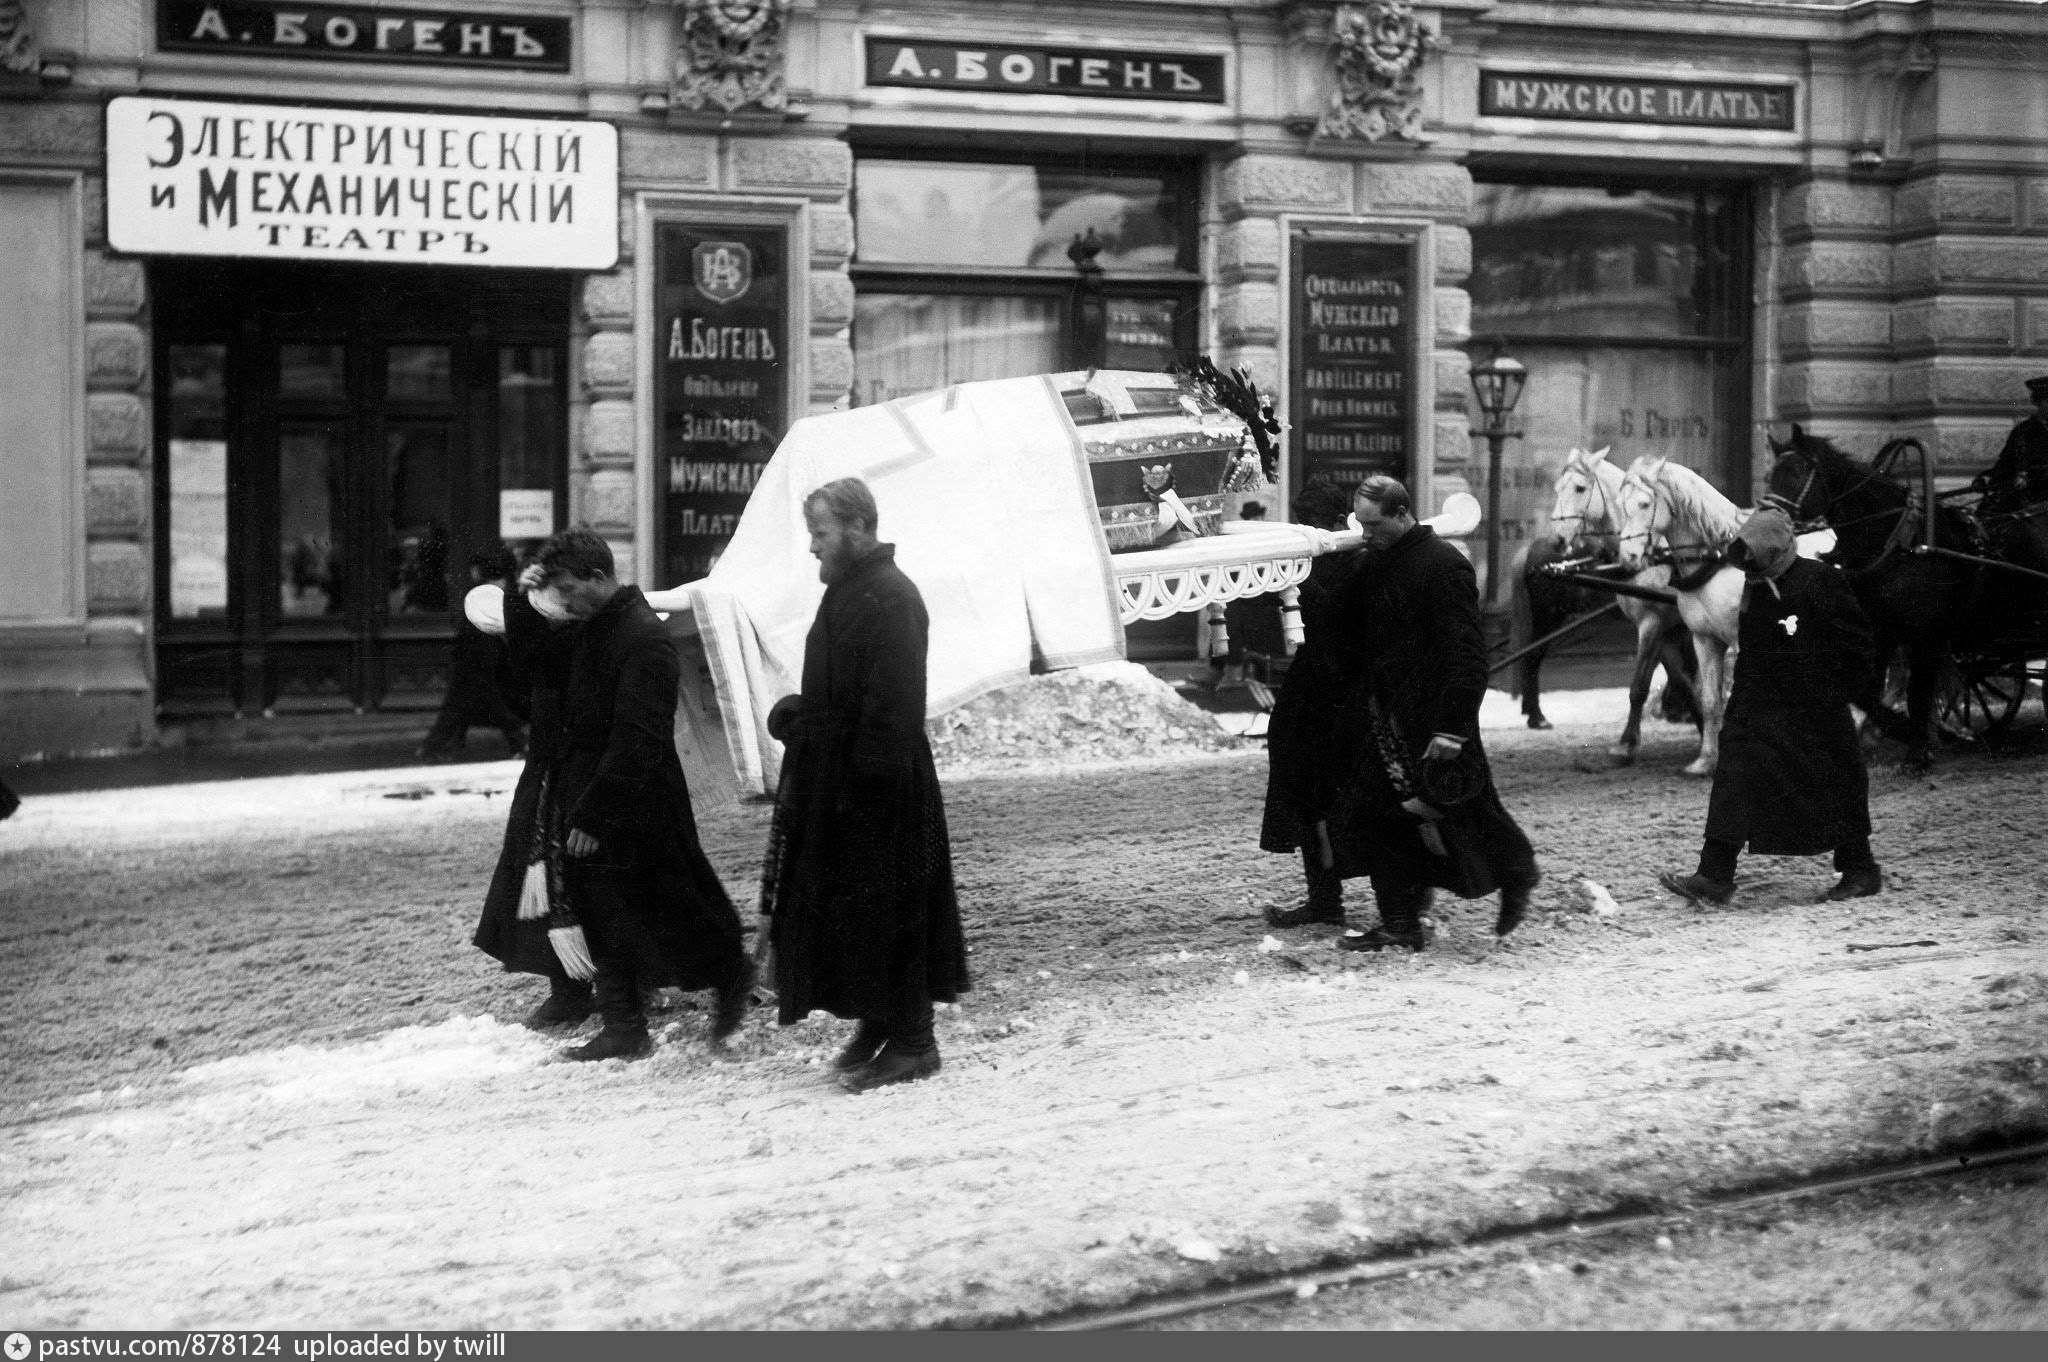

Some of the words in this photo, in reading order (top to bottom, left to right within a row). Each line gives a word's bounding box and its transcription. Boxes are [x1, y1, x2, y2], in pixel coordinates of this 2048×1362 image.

[193, 8, 252, 41] А.
[274, 12, 545, 57] БОГЕНЪ
[888, 47, 942, 78] А.
[955, 51, 1202, 91] БОГЕНЪ
[1496, 80, 1656, 115] МУЖСКОЕ
[1667, 88, 1782, 119] ПЛАТЬЕ
[147, 110, 581, 173] ЭЛЕКТРИЧЕСКІЙ
[199, 167, 574, 229] МЕХАНИЧЕСКІЙ
[258, 223, 489, 254] ТЕАТРЪ
[1311, 299, 1399, 328] МУЖСКАГО
[670, 456, 768, 494] МУЖСКАГ
[682, 509, 742, 535] ПЛАТ
